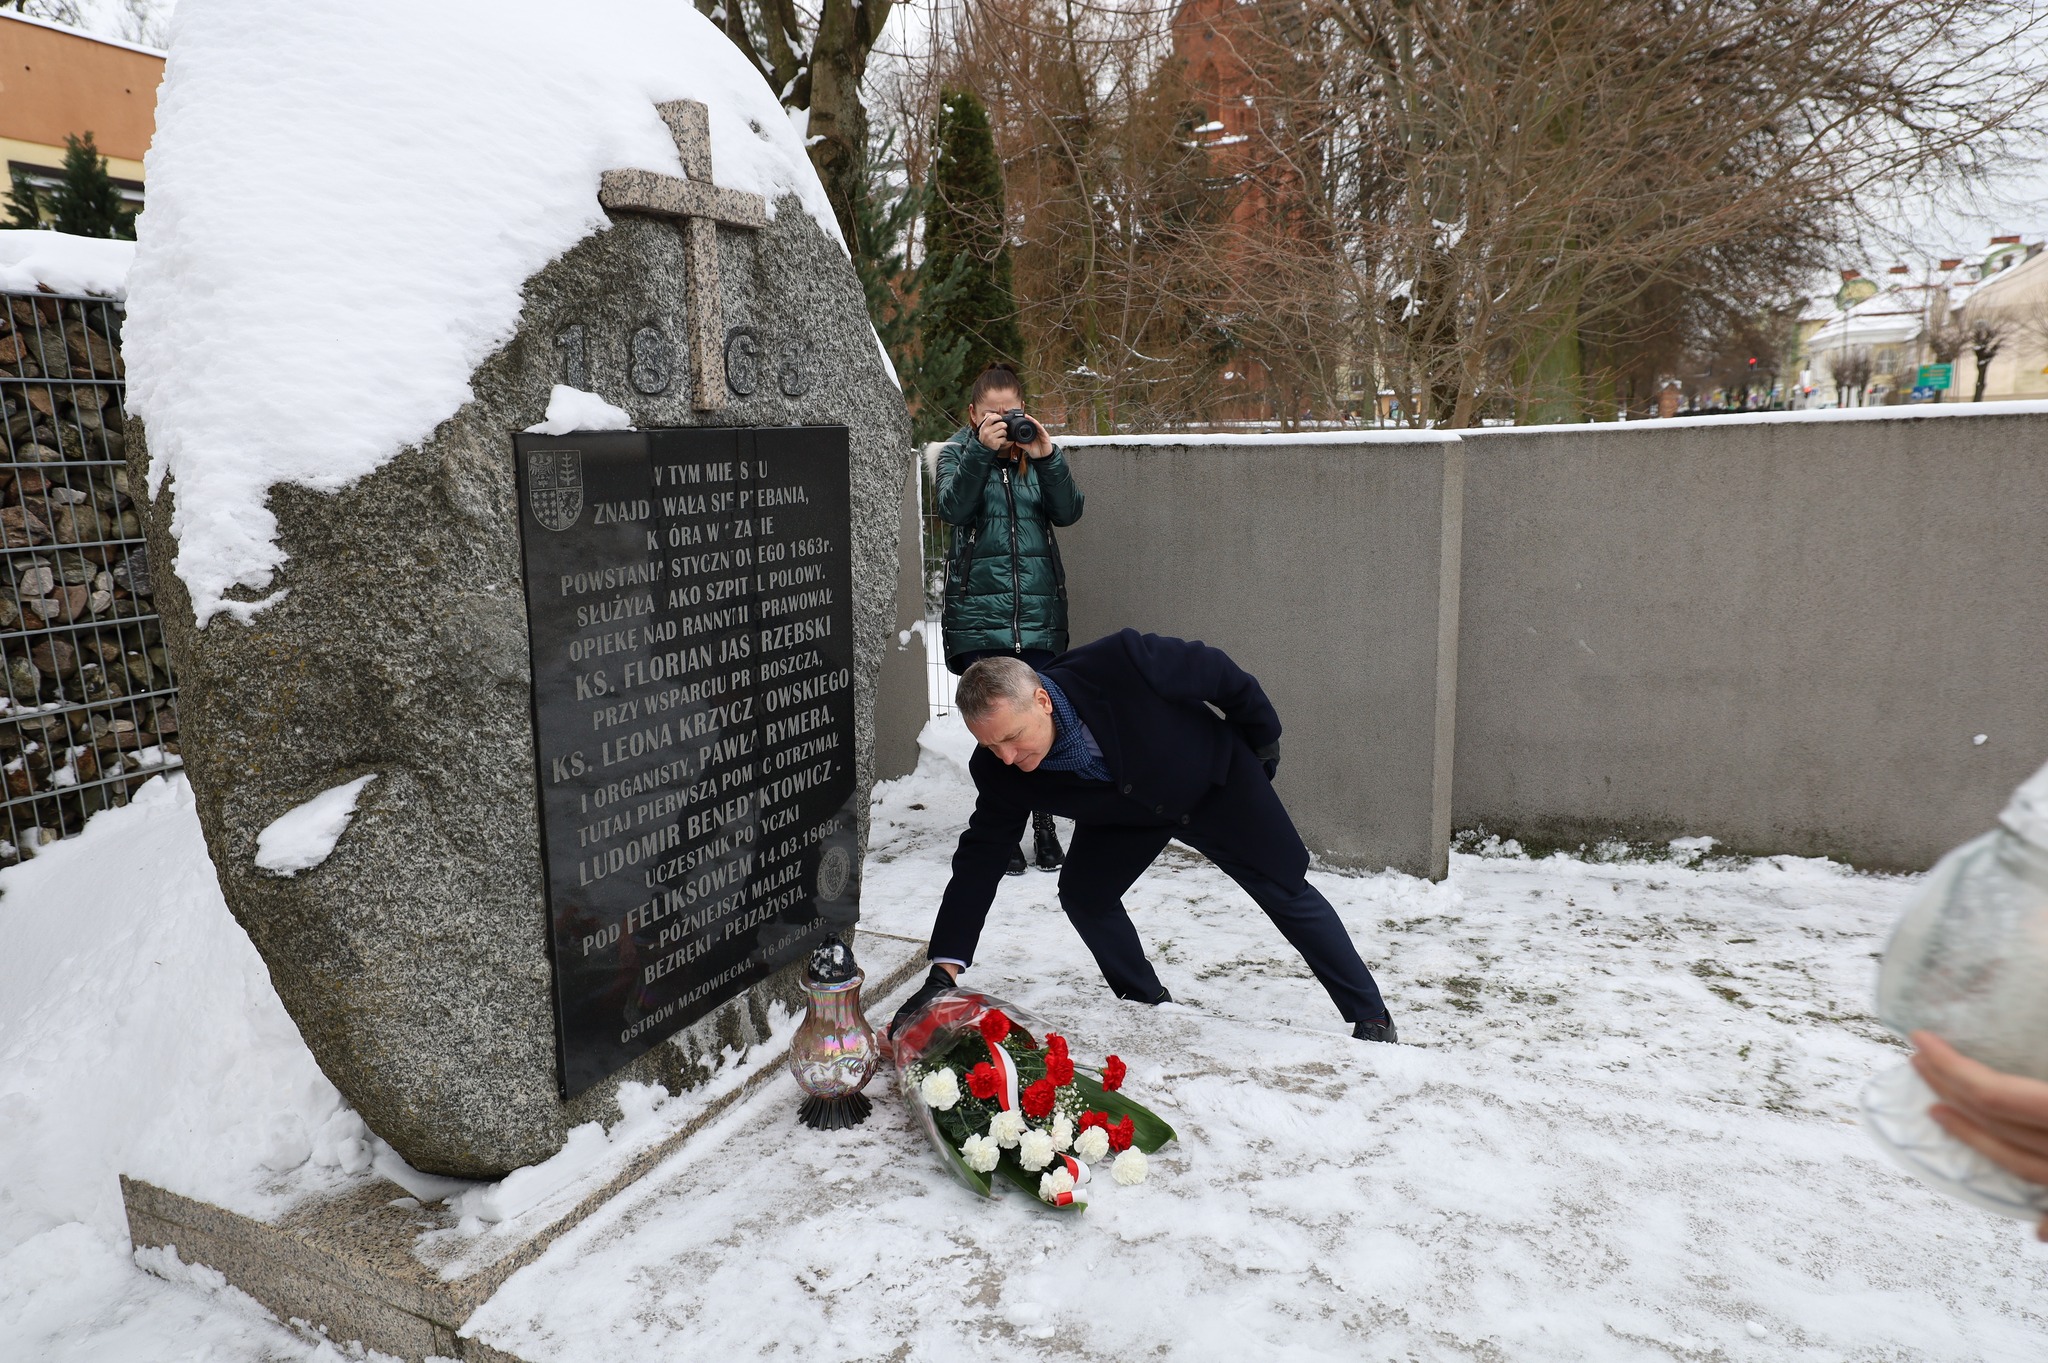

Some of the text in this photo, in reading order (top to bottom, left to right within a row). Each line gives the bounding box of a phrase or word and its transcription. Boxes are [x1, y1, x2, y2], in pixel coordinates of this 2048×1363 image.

[668, 463, 701, 485] TYM
[705, 460, 769, 483] MIESU
[739, 485, 810, 509] PEBANIA,
[647, 516, 774, 551] KÓRA W ZAIE
[561, 536, 834, 597] POWSTANIA STYCZNOEGO 1863r.
[577, 563, 826, 628] SŁUŻYŁA AKO SZPITL POLOWY.
[569, 628, 638, 662] OPIEKĘ
[643, 620, 677, 646] NAD
[575, 670, 616, 701] KS.
[624, 643, 712, 689] FLORIAN
[593, 699, 639, 730] PRZY
[644, 675, 727, 715] WSPARCIU
[552, 750, 593, 783] KS.
[602, 723, 672, 768] LEONA
[581, 704, 835, 814] I ORGANISTY, PAWŁA RYMERA.
[577, 809, 631, 847] TUTAJ
[637, 777, 718, 825] PIERWSZĄ
[775, 731, 840, 770] OTRZYMAŁ
[579, 826, 681, 887] LUDOMIR
[645, 803, 800, 889] UCZESTNIK POYCZKI
[582, 818, 843, 957] POD FELIKSOWEM 14.03.1863r.
[659, 889, 748, 950] PÓŹNIEJSZY
[751, 859, 803, 901] MALARZ
[644, 936, 712, 987] BEZRĘKI
[725, 885, 807, 941] PEJZAŻYSTA.
[620, 914, 827, 1044] OSTRÓW MAZOWIECKA, 16.06.2013r.
